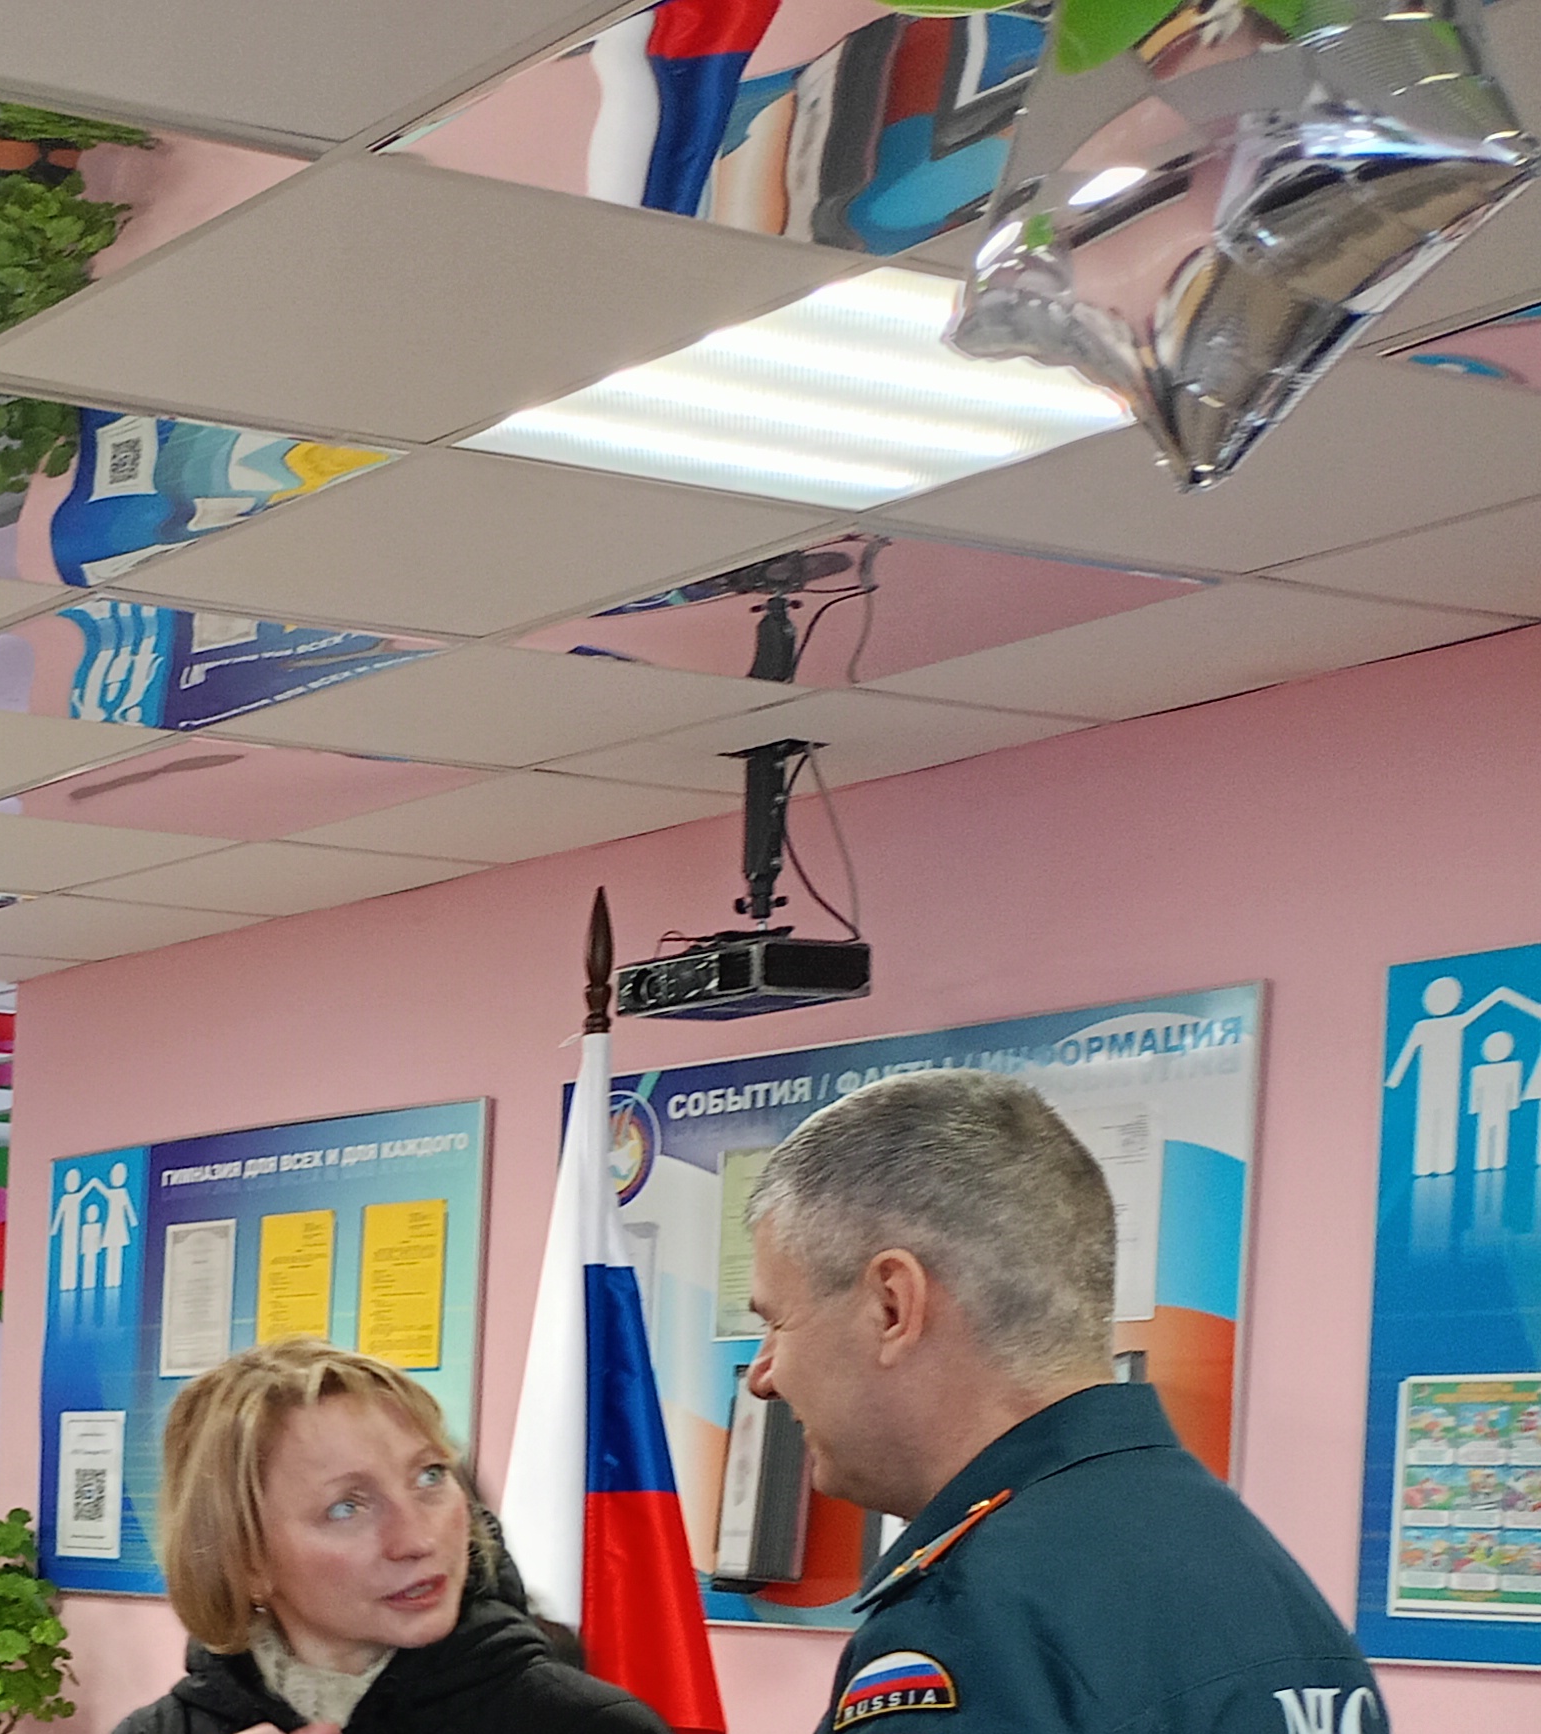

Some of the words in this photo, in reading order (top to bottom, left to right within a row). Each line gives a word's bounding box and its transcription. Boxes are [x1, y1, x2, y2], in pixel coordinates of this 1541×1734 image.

[667, 1077, 811, 1120] СОБЫТИЯ
[279, 1150, 323, 1172] ВСЕХ
[325, 1147, 340, 1166] И
[380, 1132, 469, 1159] КАЖДОГО
[843, 1688, 937, 1720] RUSSIA
